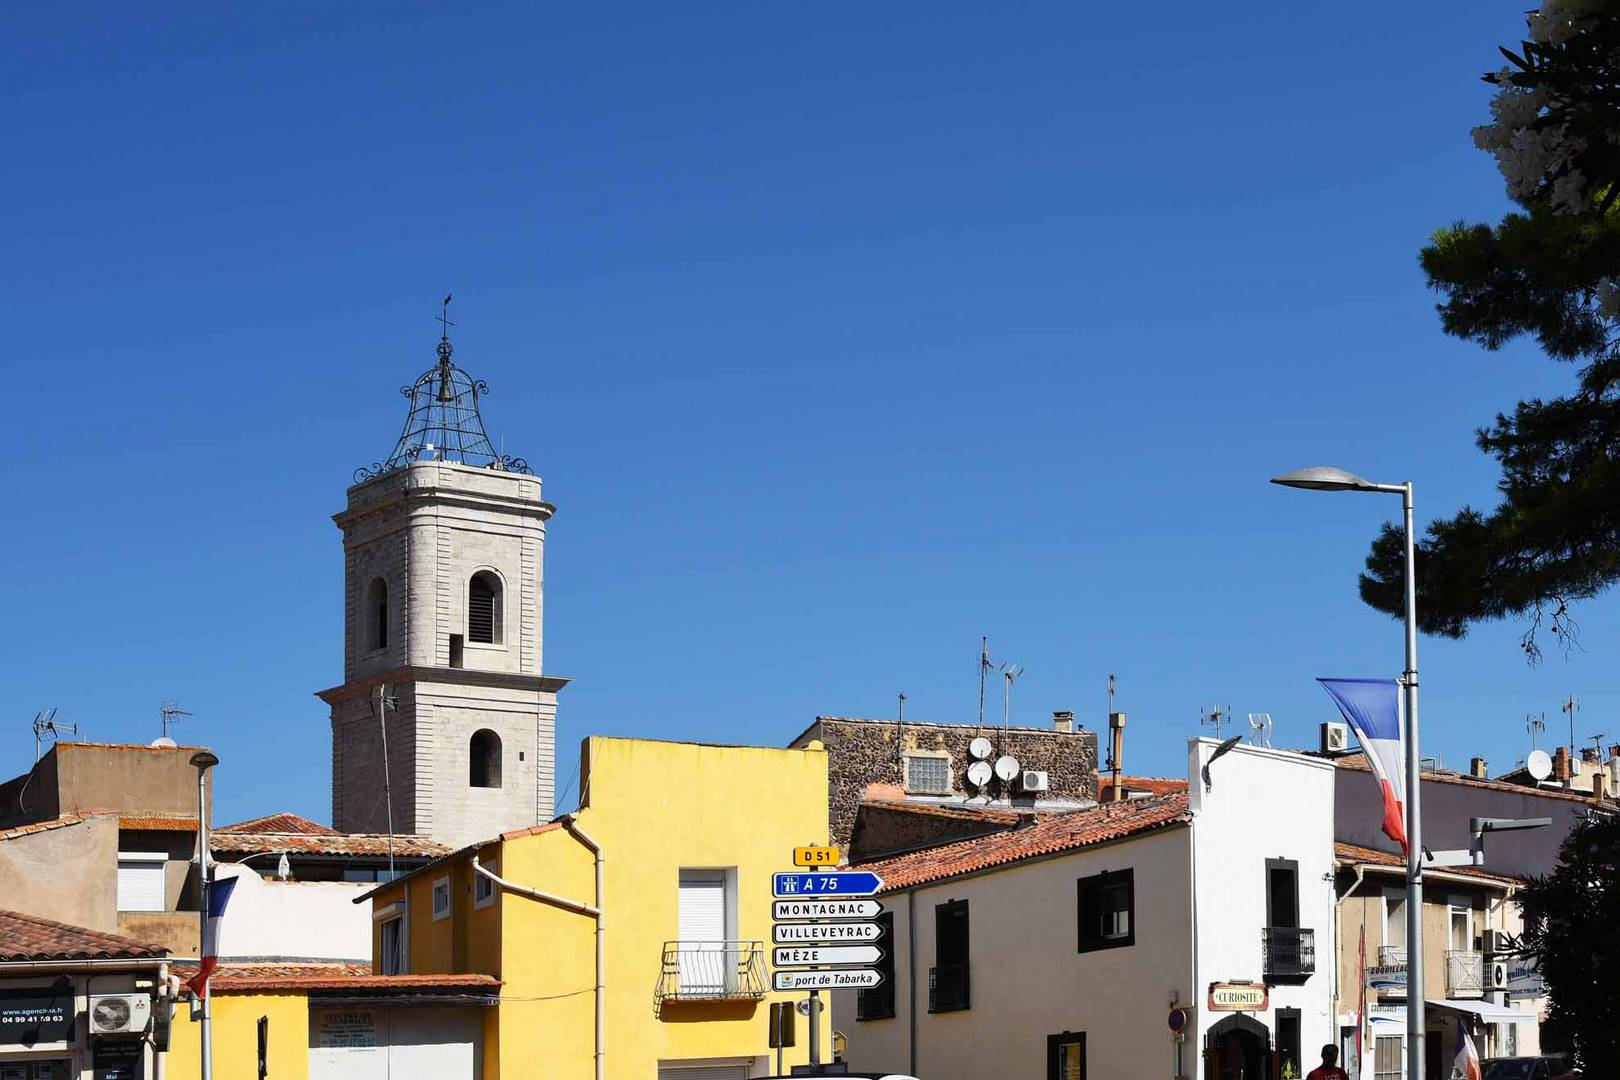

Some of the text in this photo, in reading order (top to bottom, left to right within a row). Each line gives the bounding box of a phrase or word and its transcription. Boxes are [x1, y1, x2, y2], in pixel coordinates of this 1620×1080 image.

[805, 852, 830, 861] D 51
[804, 878, 838, 891] A 75
[780, 904, 864, 915] MONTAGNAC
[780, 927, 871, 938] VILLEVEYRAC
[780, 949, 819, 961] MÈZE
[795, 974, 873, 987] port de Tabarka
